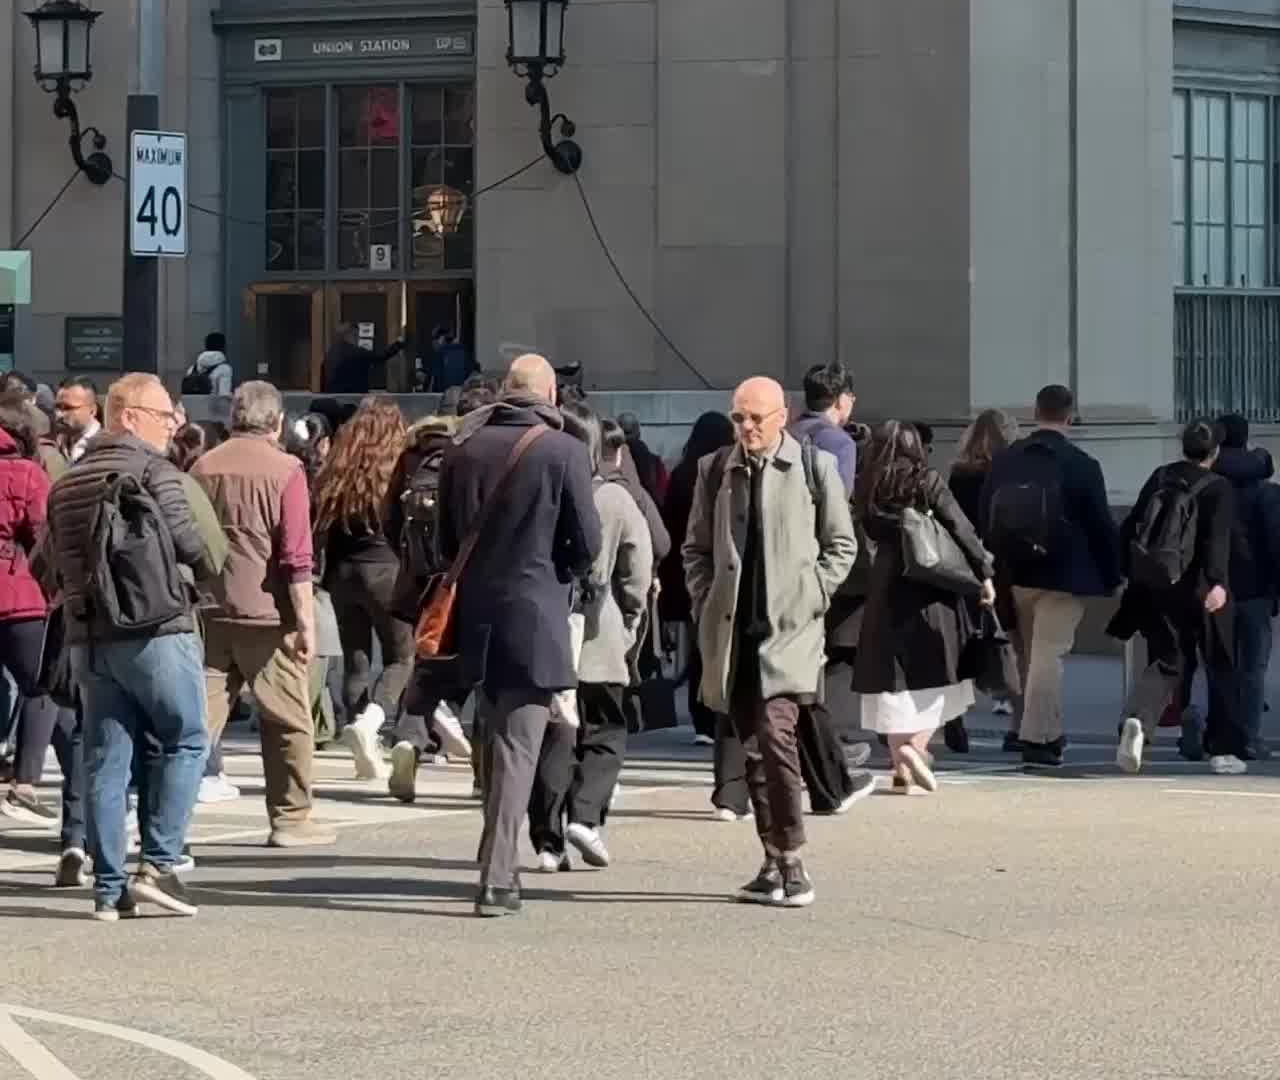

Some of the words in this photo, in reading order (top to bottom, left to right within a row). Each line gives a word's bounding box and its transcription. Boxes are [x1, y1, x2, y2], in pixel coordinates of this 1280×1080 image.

[312, 40, 353, 54] UNION
[360, 39, 410, 53] STATION
[136, 146, 182, 166] MAXIMUM
[136, 184, 182, 237] 40
